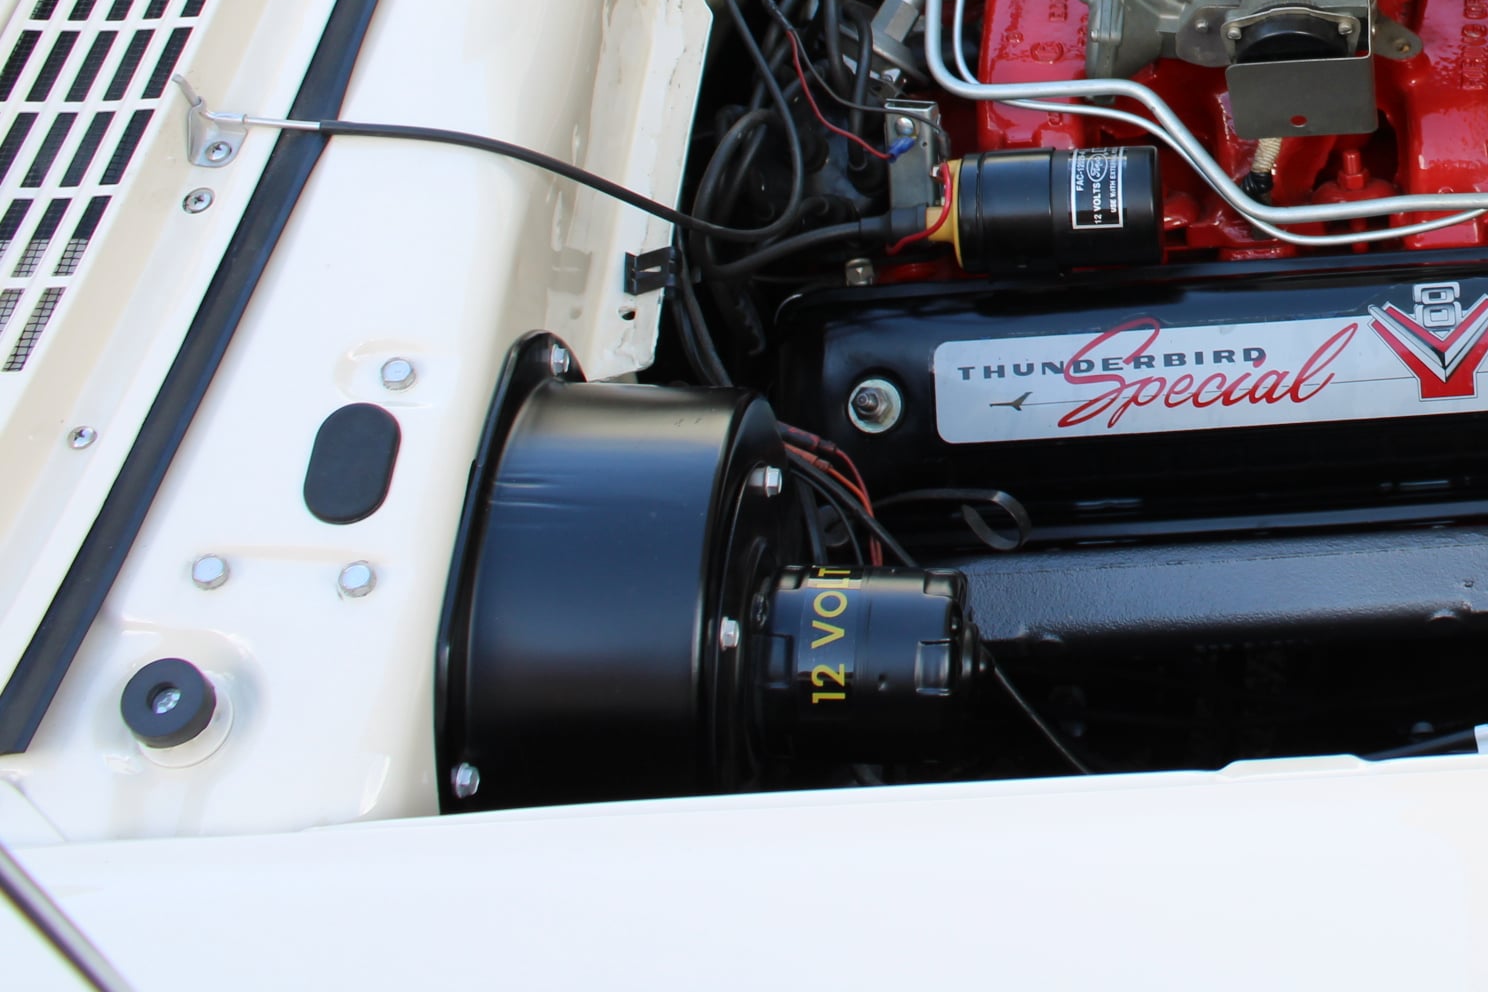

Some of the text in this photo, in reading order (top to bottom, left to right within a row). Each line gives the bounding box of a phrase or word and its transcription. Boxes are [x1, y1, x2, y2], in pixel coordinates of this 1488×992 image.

[1092, 182, 1103, 224] 12 VOLTS
[957, 346, 1266, 380] THUNDERBIRD
[1058, 317, 1358, 428] Special
[810, 567, 851, 704] 12 VOLT
